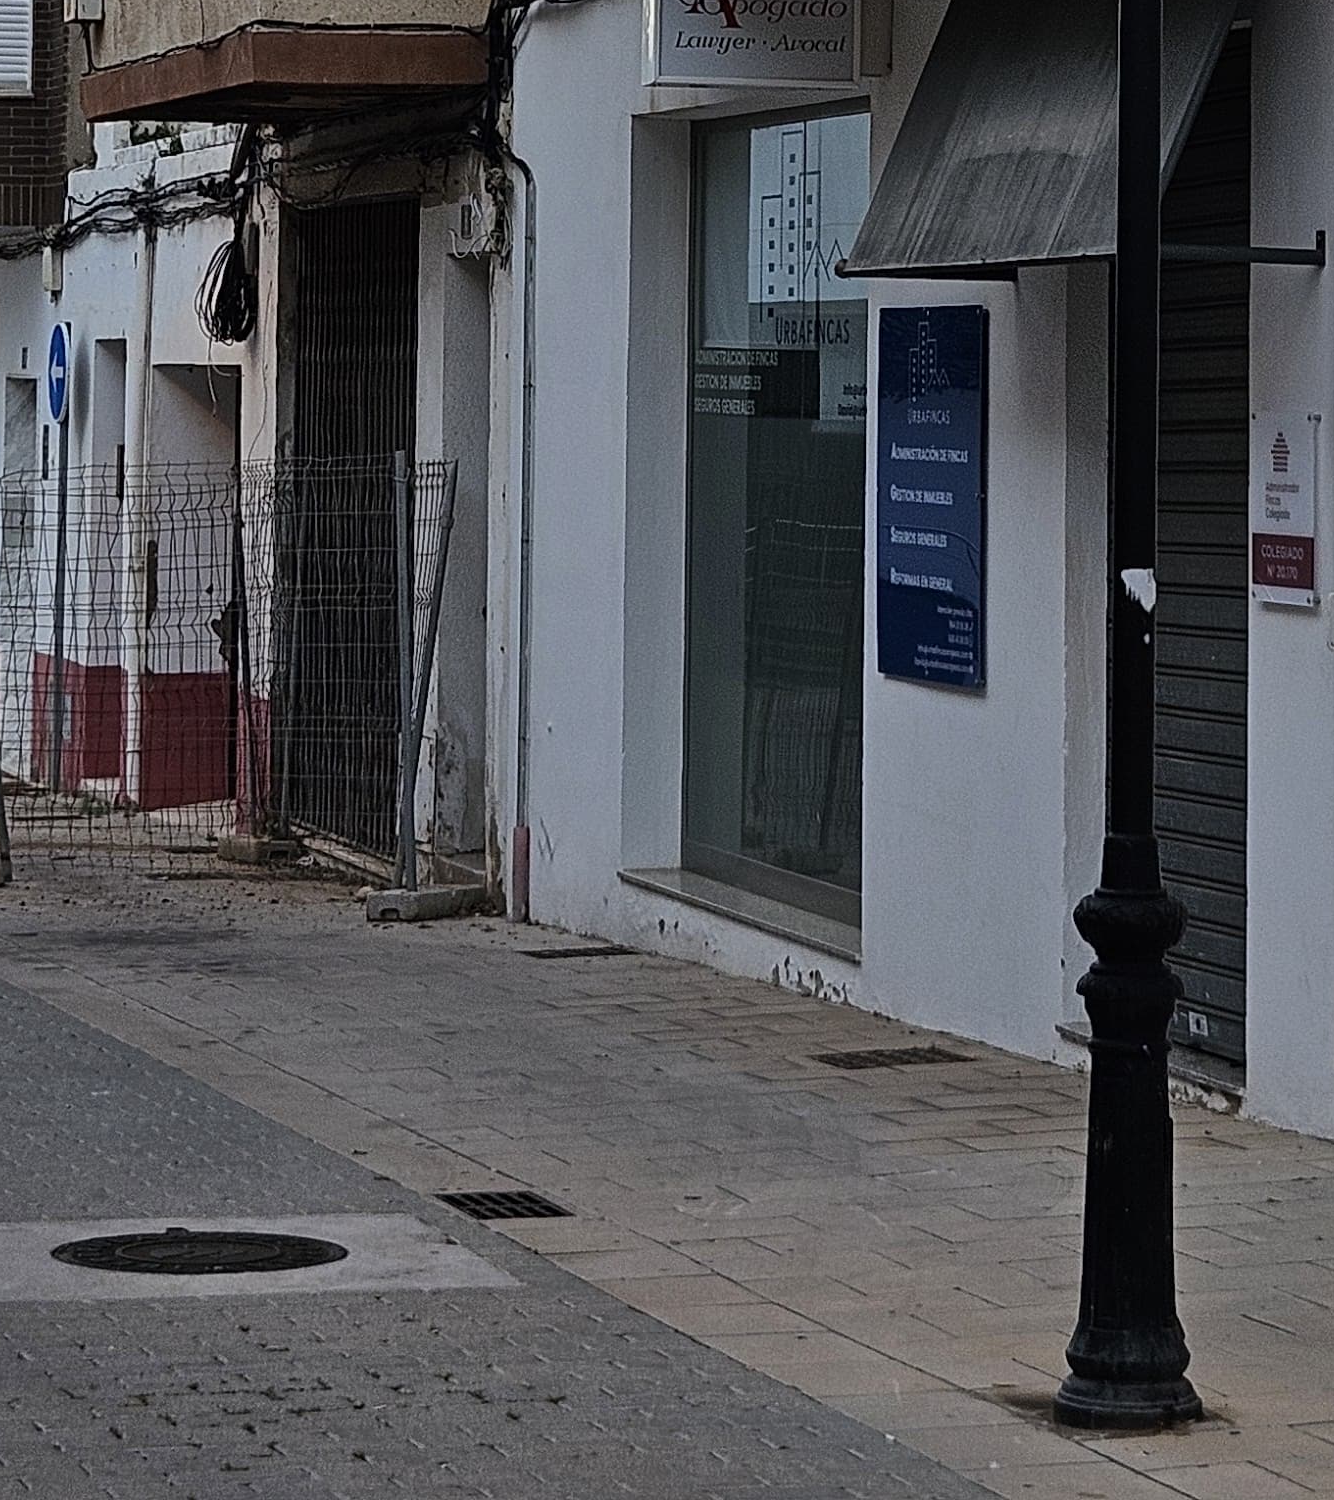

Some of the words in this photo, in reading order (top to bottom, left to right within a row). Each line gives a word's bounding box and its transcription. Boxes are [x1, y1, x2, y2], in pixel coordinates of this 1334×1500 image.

[675, 30, 756, 55] Lawyer
[770, 33, 848, 53] Avocat
[1260, 544, 1305, 561] COLEGIADO
